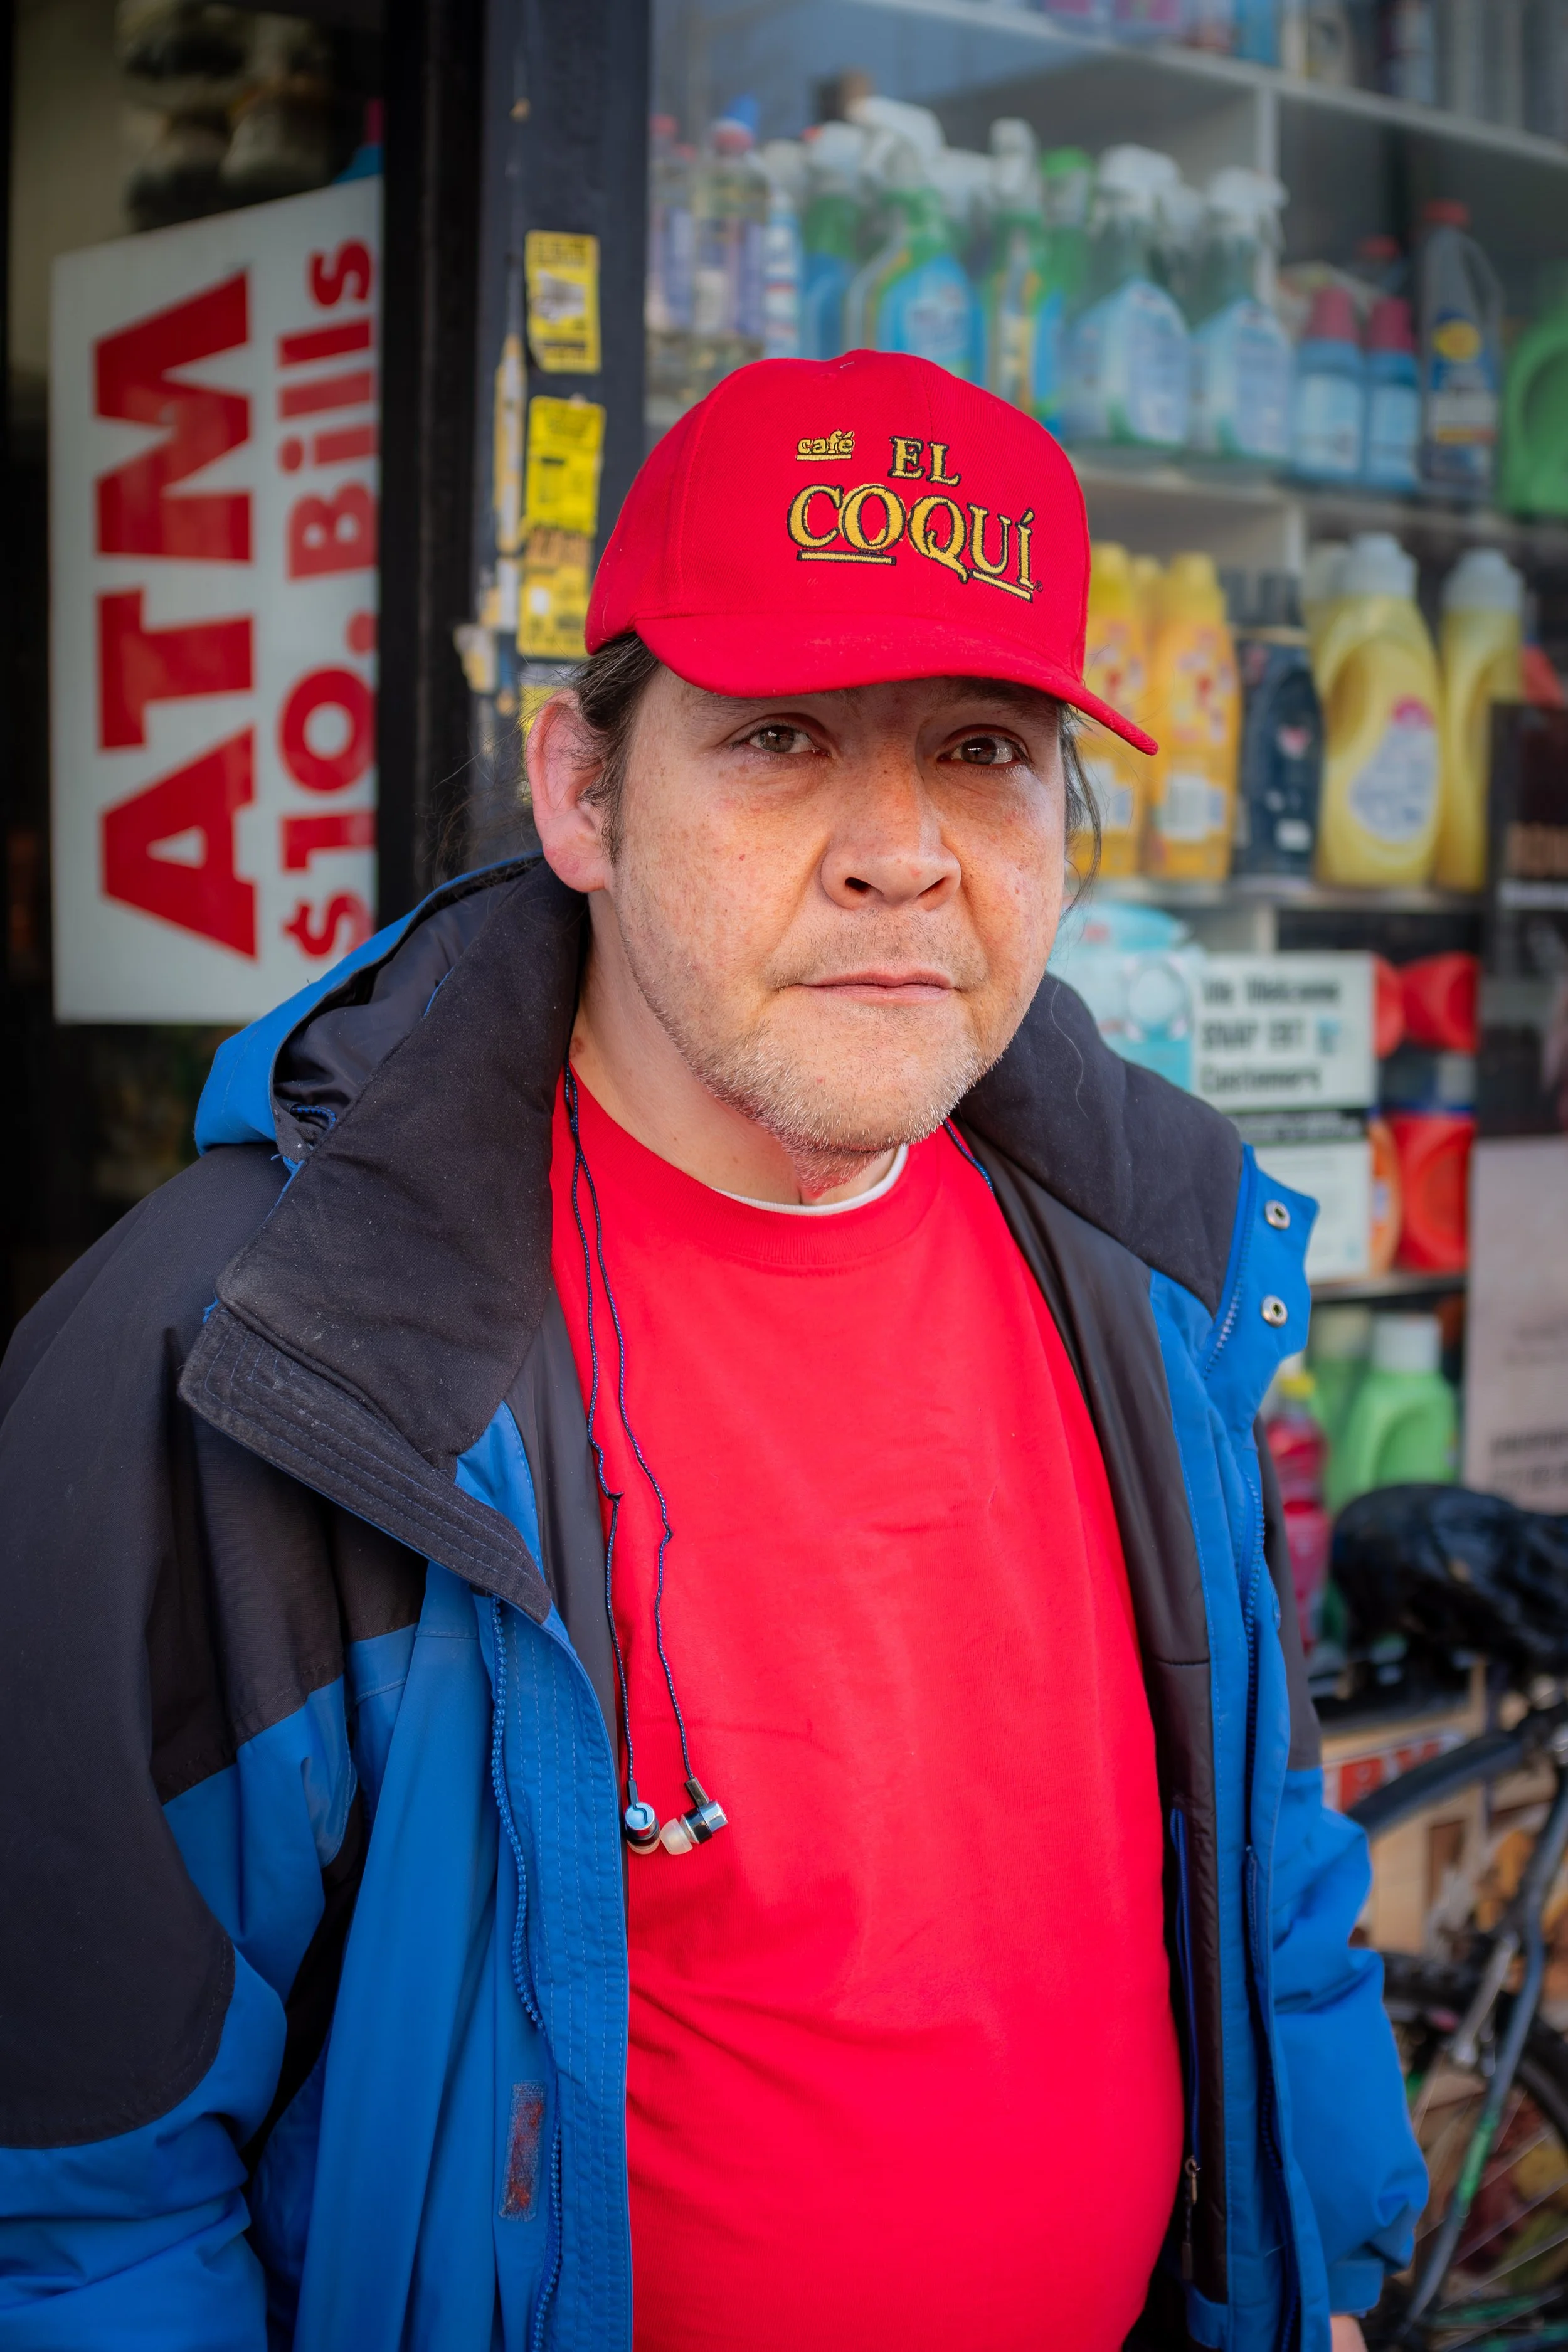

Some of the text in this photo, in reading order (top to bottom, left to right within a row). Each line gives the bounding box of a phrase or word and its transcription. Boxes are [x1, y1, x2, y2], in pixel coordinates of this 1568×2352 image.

[796, 429, 856, 455] café
[888, 435, 962, 487] EL
[787, 483, 1035, 592] COQUÍ
[95, 273, 258, 960] ATM
[277, 242, 376, 960] $10. Bills
